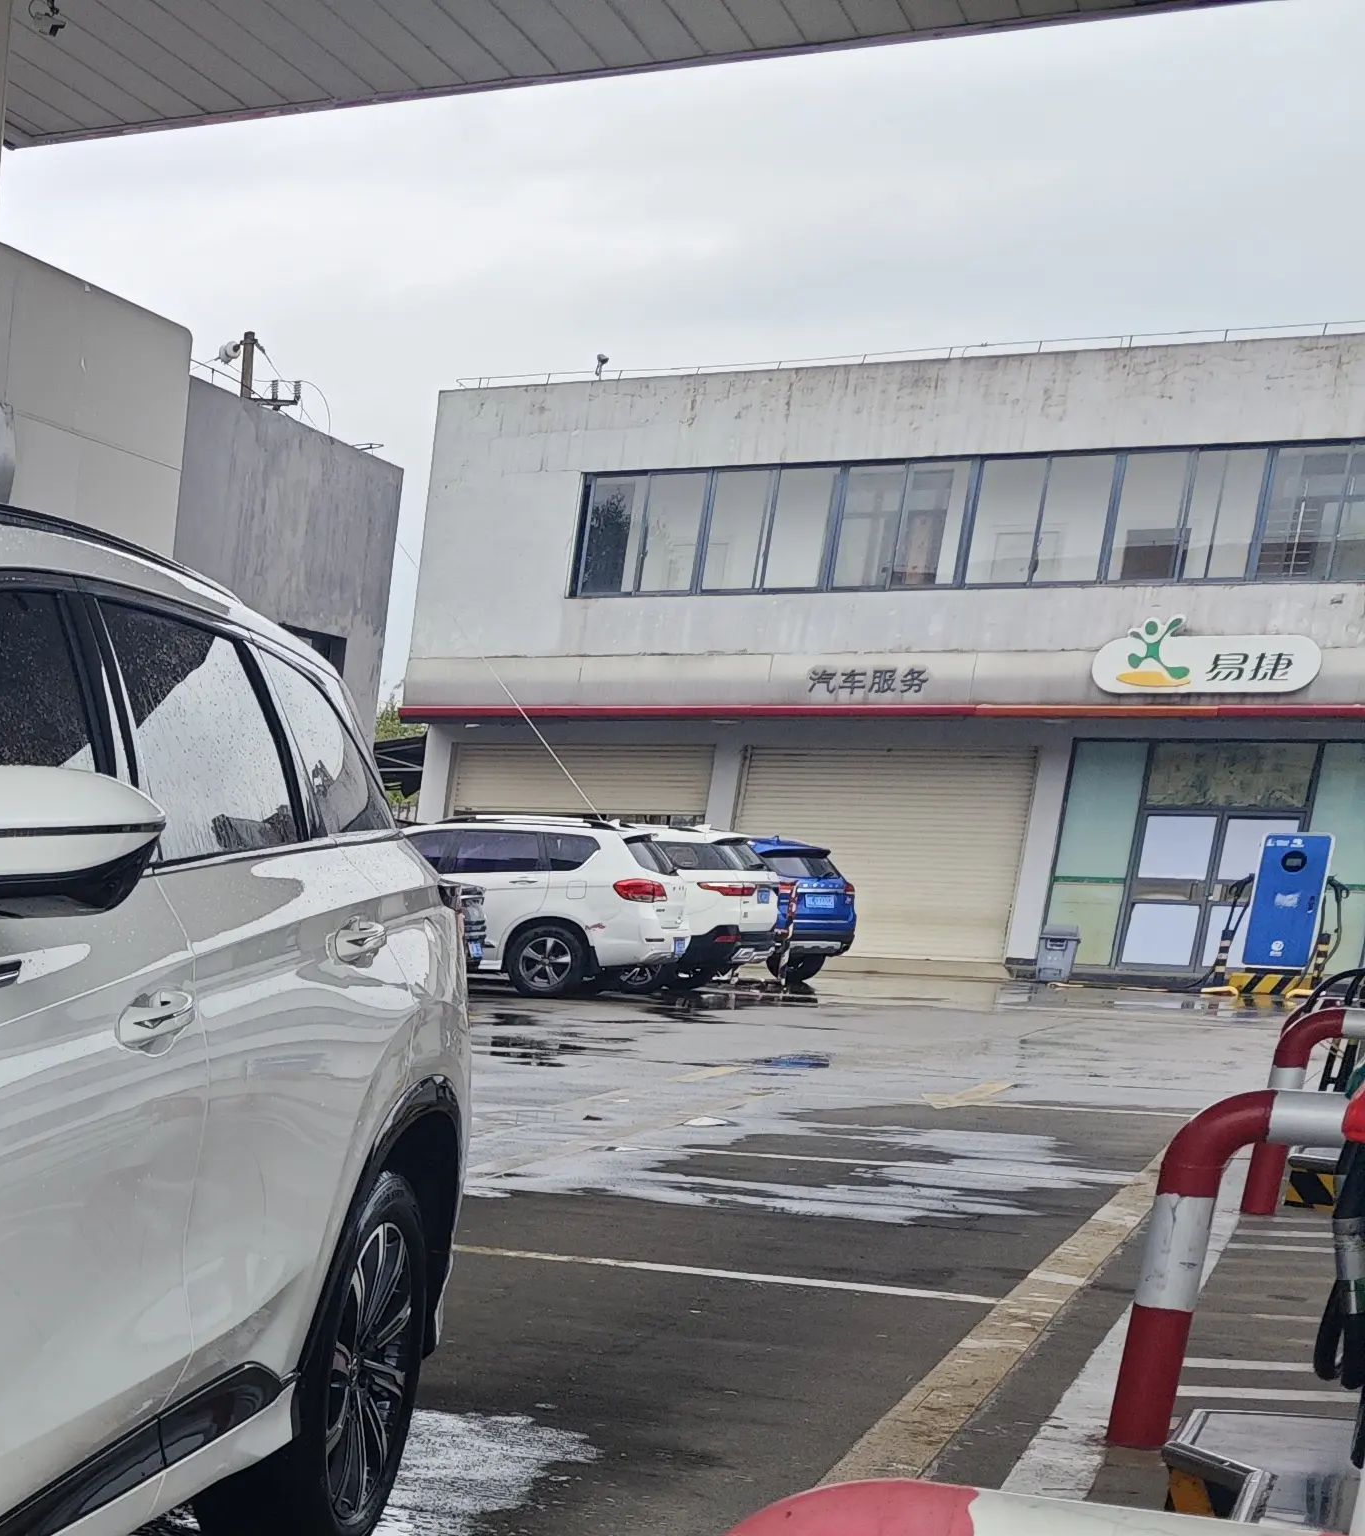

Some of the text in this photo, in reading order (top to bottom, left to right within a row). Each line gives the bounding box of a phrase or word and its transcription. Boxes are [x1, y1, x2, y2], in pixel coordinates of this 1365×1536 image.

[807, 667, 931, 695] 汽车服务
[1204, 651, 1295, 682] 易捷
